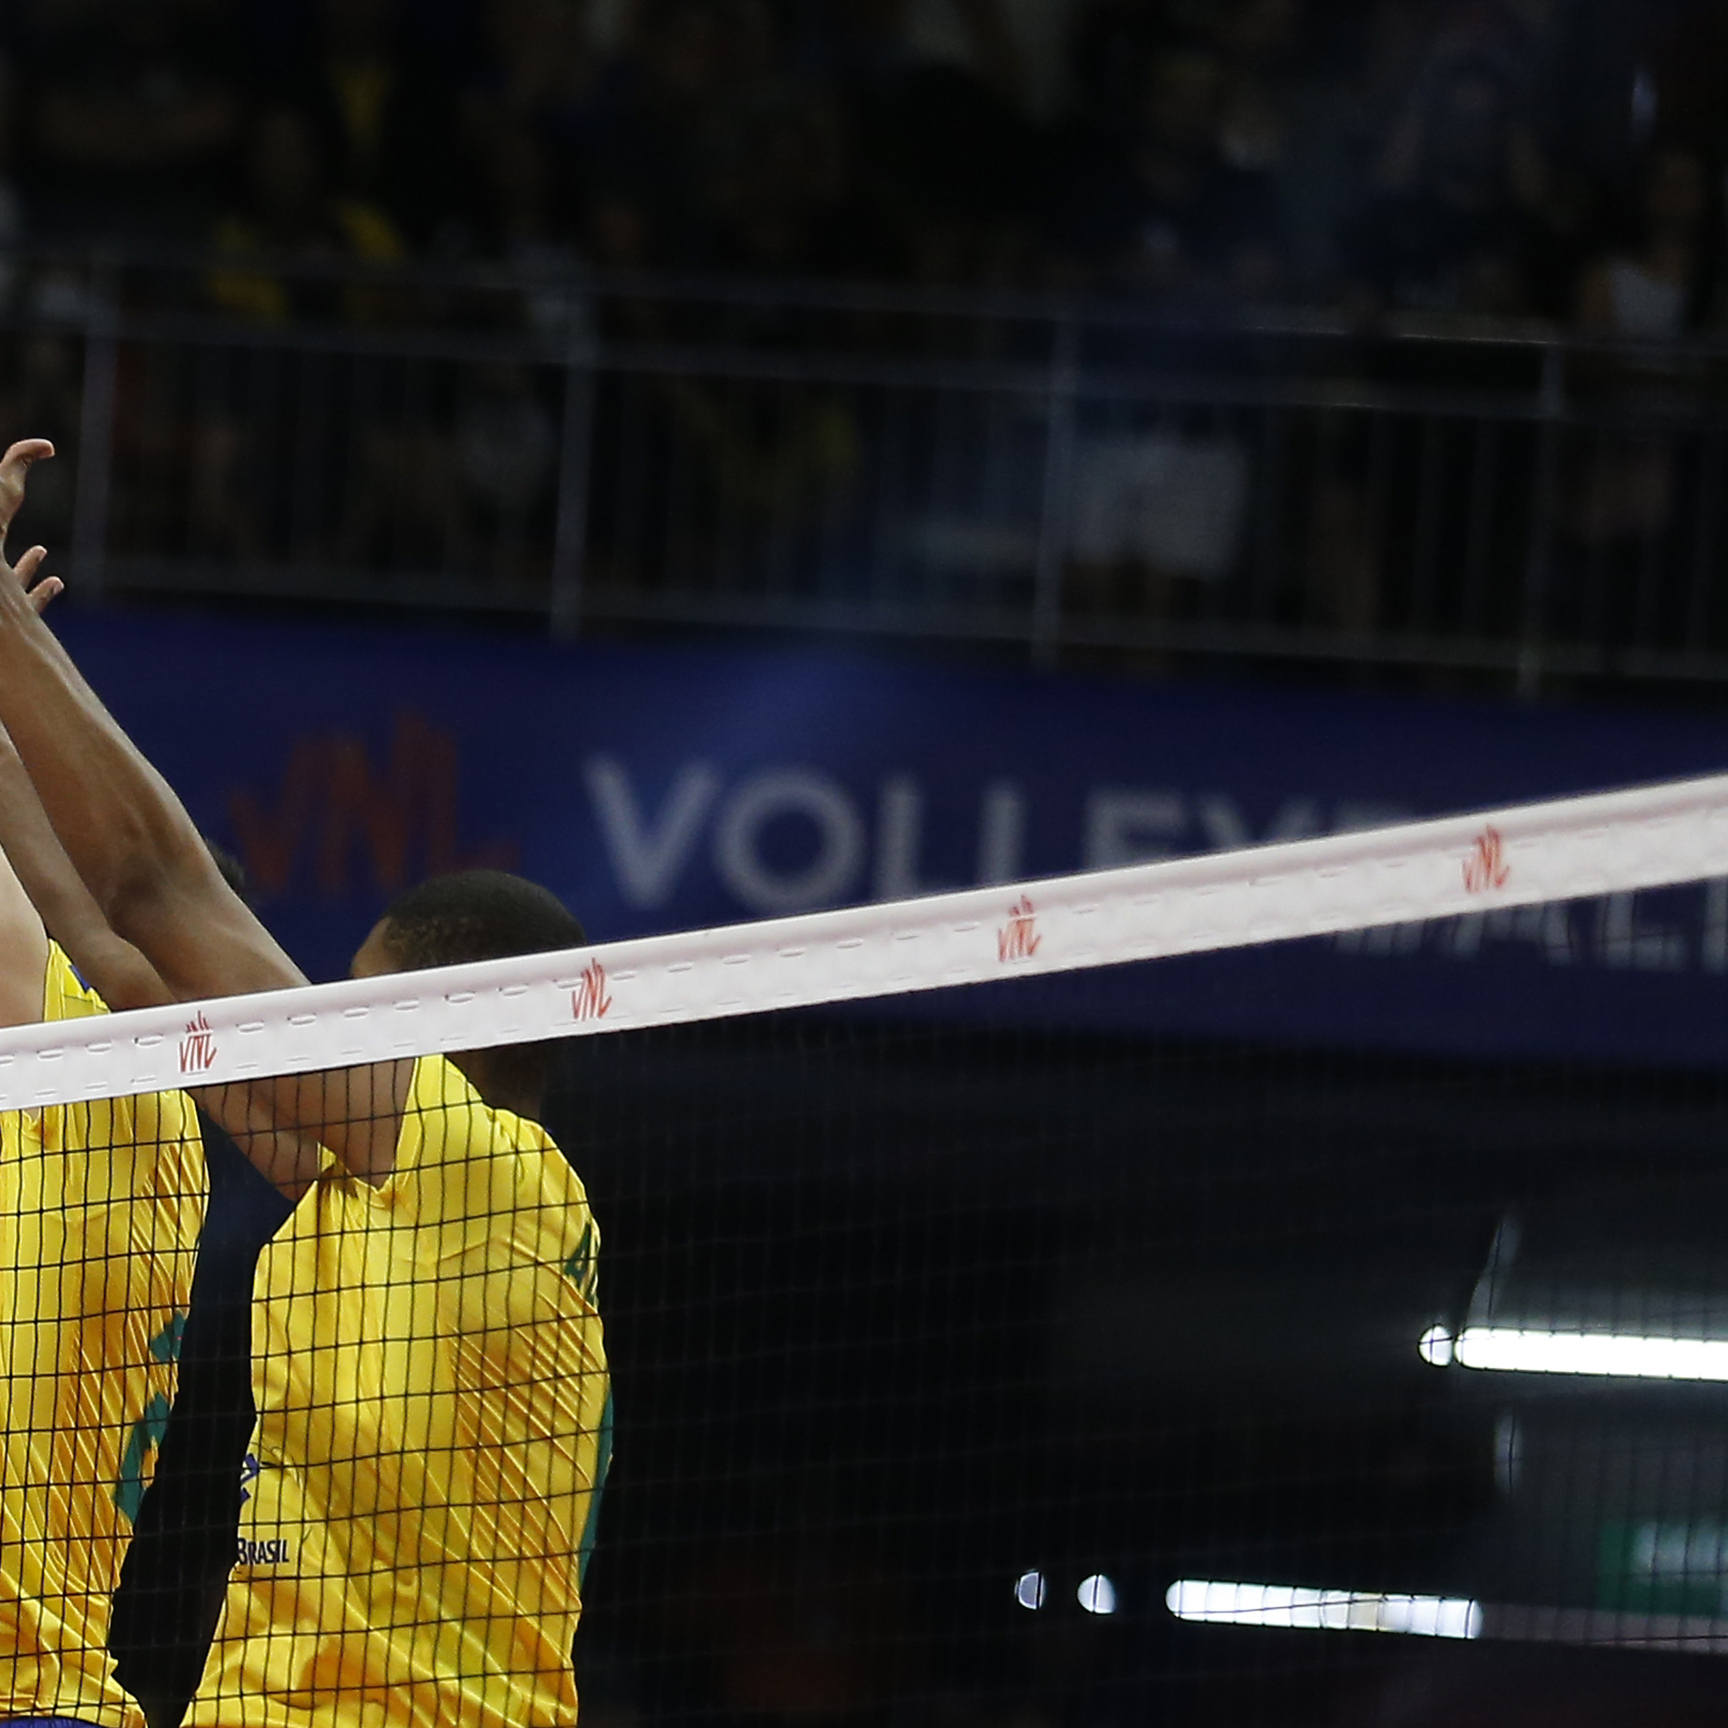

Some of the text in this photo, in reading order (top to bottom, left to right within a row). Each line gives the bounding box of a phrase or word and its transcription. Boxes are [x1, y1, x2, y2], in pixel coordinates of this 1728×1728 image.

[1460, 822, 1510, 893] VNL
[996, 894, 1043, 966] VNL
[570, 957, 612, 1022] VNL
[178, 1011, 218, 1073] VNL
[236, 1537, 290, 1566] BRASIL
